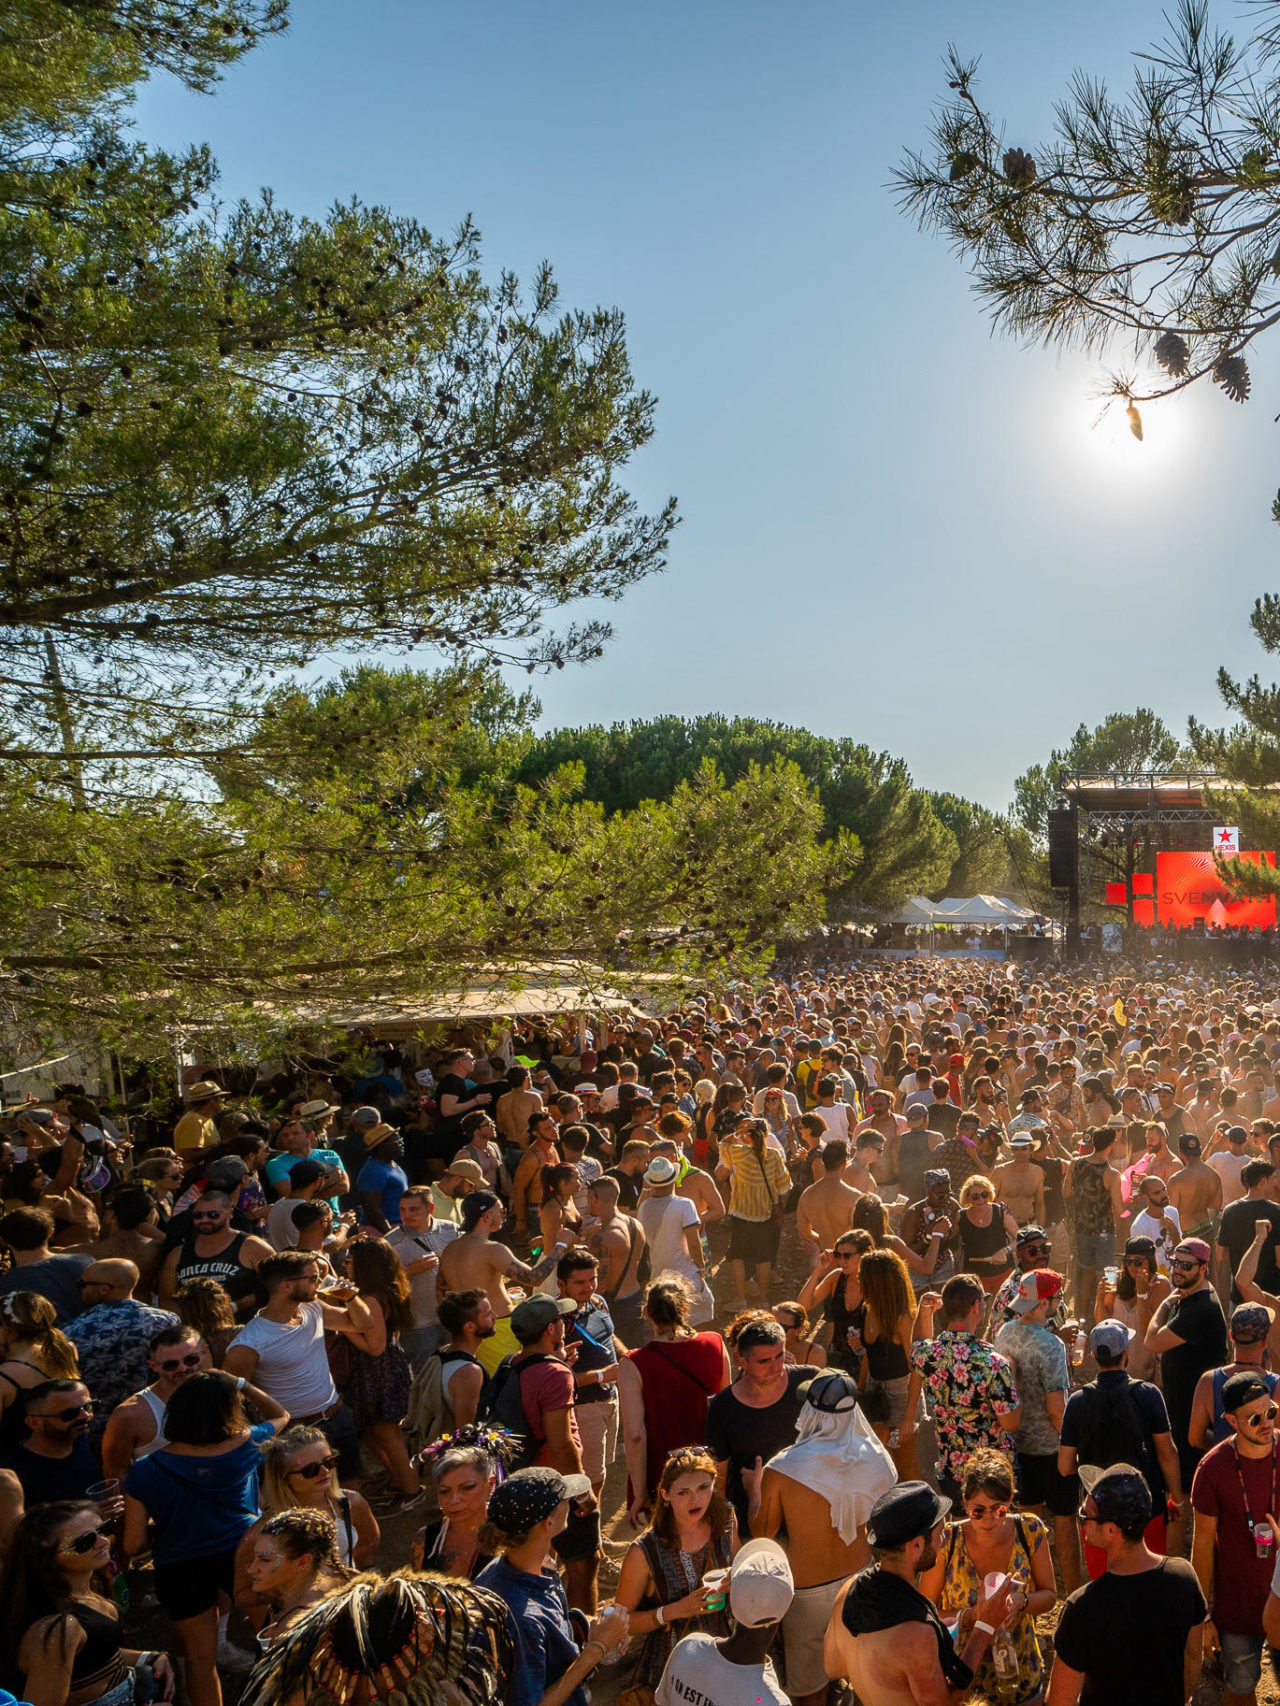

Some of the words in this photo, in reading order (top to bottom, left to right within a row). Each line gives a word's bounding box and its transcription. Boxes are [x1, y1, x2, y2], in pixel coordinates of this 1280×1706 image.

[1162, 891, 1216, 905] SVEN
[209, 1262, 240, 1277] CRUZ
[683, 1686, 704, 1706] EST
